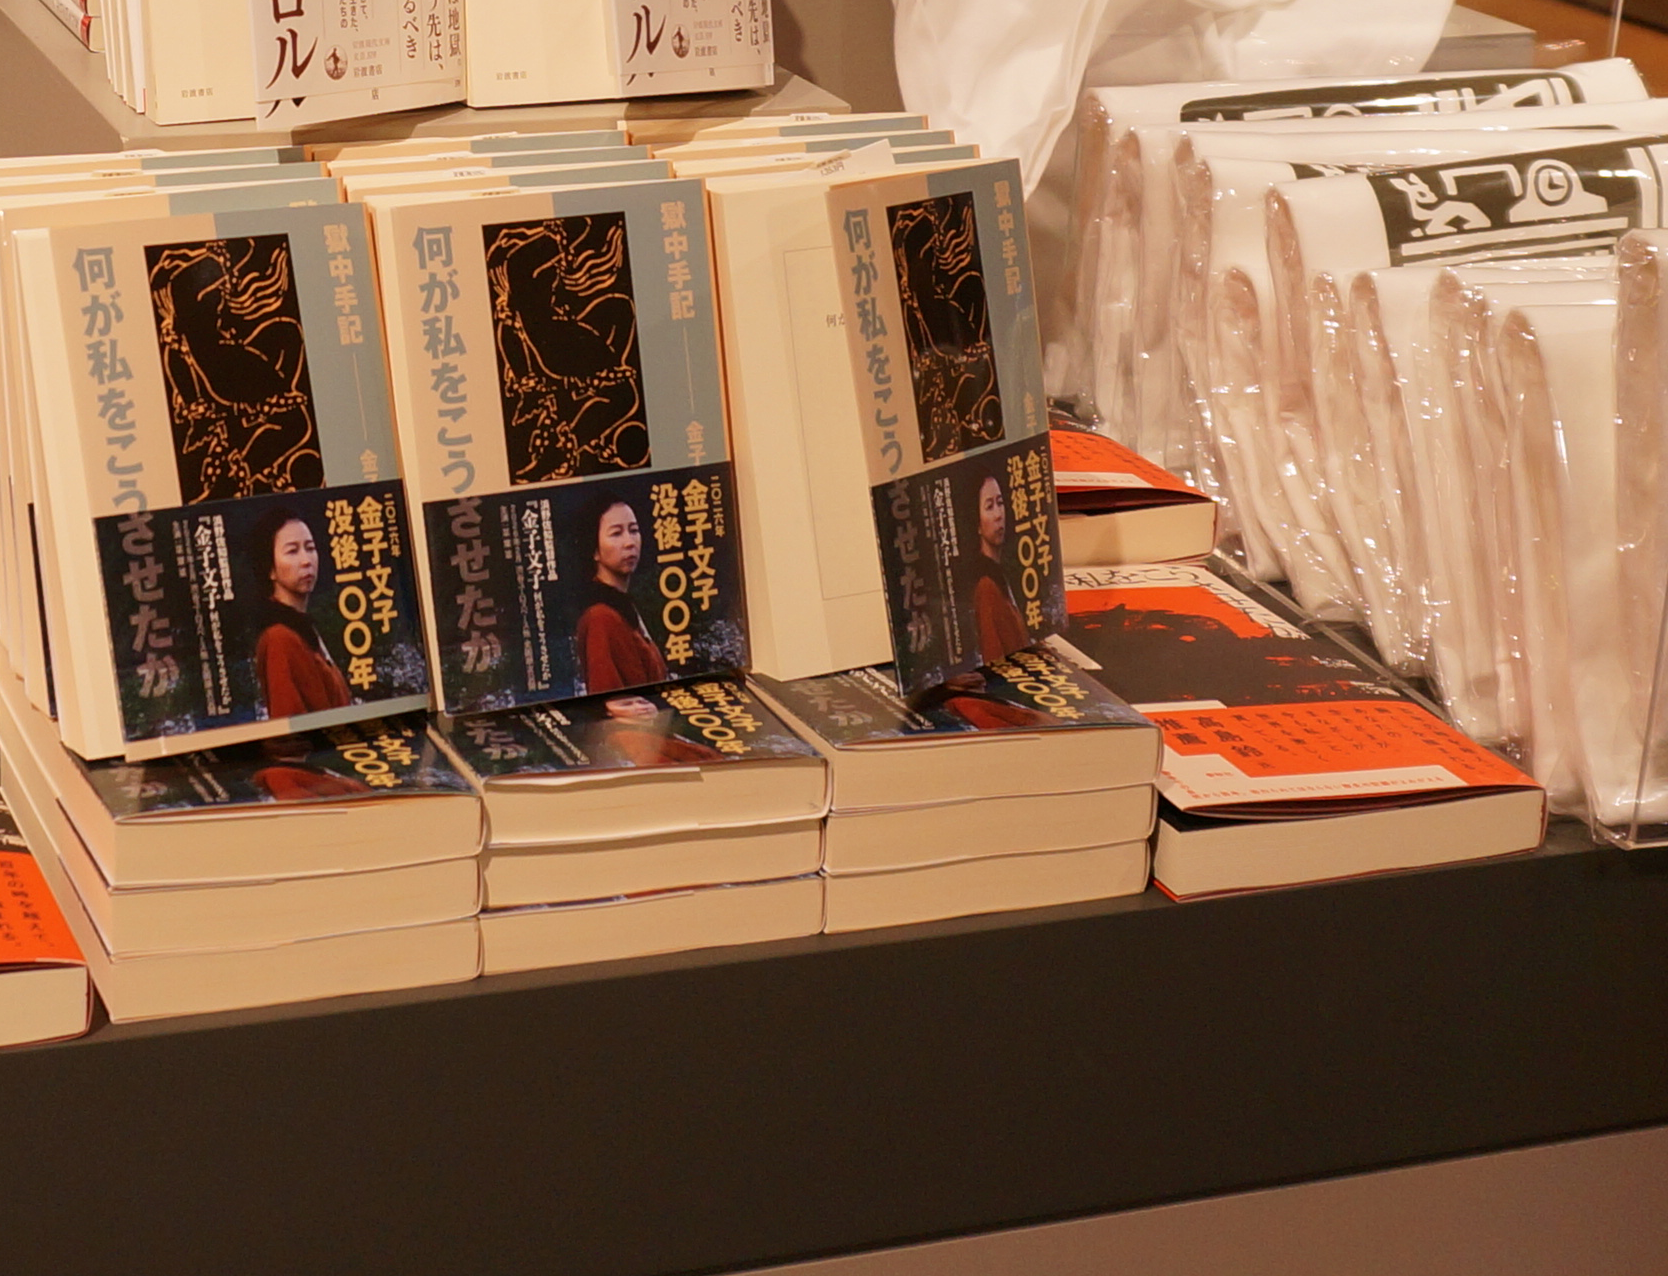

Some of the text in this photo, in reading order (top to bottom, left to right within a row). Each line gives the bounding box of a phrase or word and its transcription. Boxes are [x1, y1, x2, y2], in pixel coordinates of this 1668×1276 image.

[323, 224, 366, 346] 獄中手記
[660, 201, 697, 320] 獄中手記
[993, 180, 1024, 296] 獄中手記
[73, 245, 181, 700] 何が私をこうさせたか
[413, 225, 501, 675] 何が私をこうさせたか
[843, 208, 934, 655] 何が私をこうさせたか
[355, 494, 399, 635] 金子文子
[650, 483, 695, 666] 没後一〇〇年
[681, 478, 719, 613] 金子文子
[1007, 455, 1043, 633] 没後一〇〇年
[1023, 448, 1053, 578] 金子文子
[325, 499, 378, 692] 没後一〇〇年
